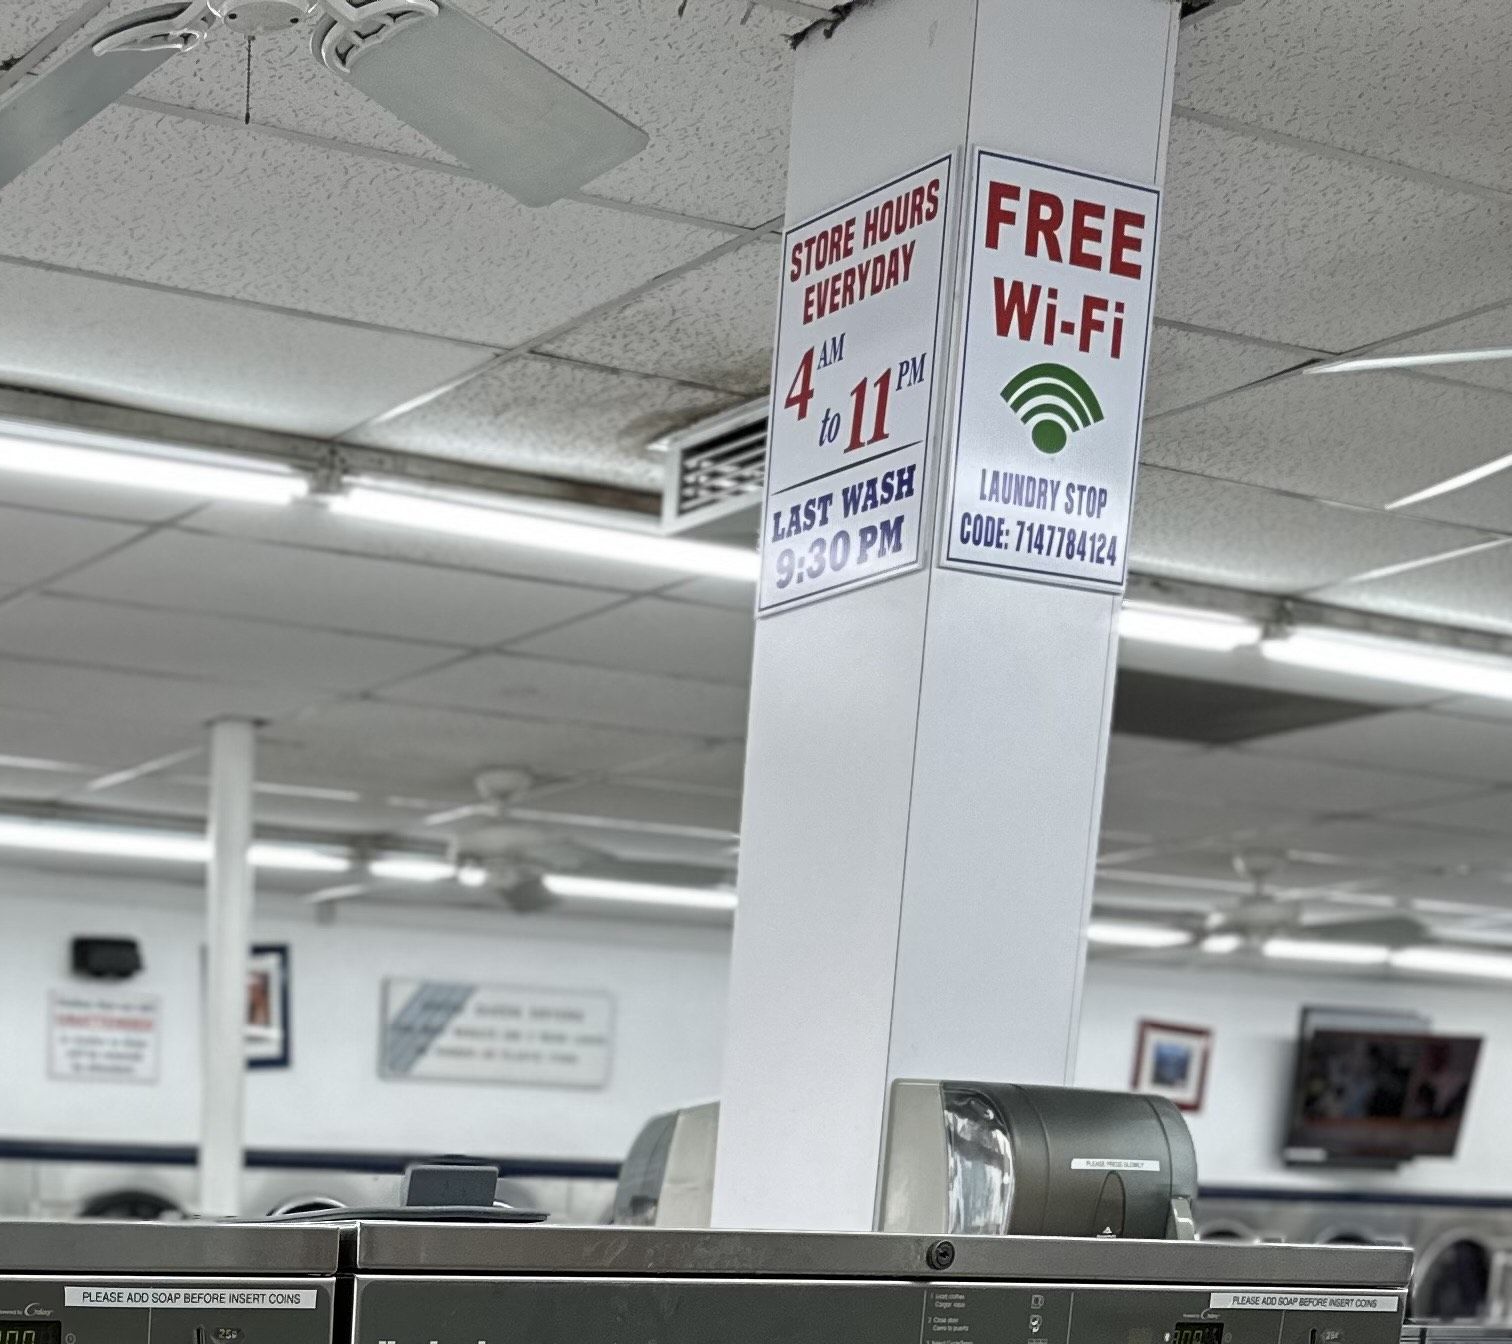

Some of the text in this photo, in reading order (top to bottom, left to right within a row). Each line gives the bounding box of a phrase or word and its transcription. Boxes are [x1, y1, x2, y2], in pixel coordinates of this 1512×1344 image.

[790, 179, 940, 283] STORE HOURS
[985, 180, 1146, 280] FREE
[802, 240, 916, 326] EVERYDAY
[993, 276, 1125, 360] Wi-Fi
[784, 333, 846, 421] 4 AM
[819, 353, 926, 454] to 11 PM
[772, 464, 917, 544] LAST WASH
[979, 468, 1107, 519] LAUNDRY STOP
[776, 515, 904, 590] 9:30 PM
[960, 512, 1118, 567] CODE: 7147784124
[83, 1292, 300, 1304] PLEASE ADD SOAP BEFORE INSERT COINS
[1232, 1296, 1377, 1308] PLEASE ADD SOAP BEFORE INSERT COINS
